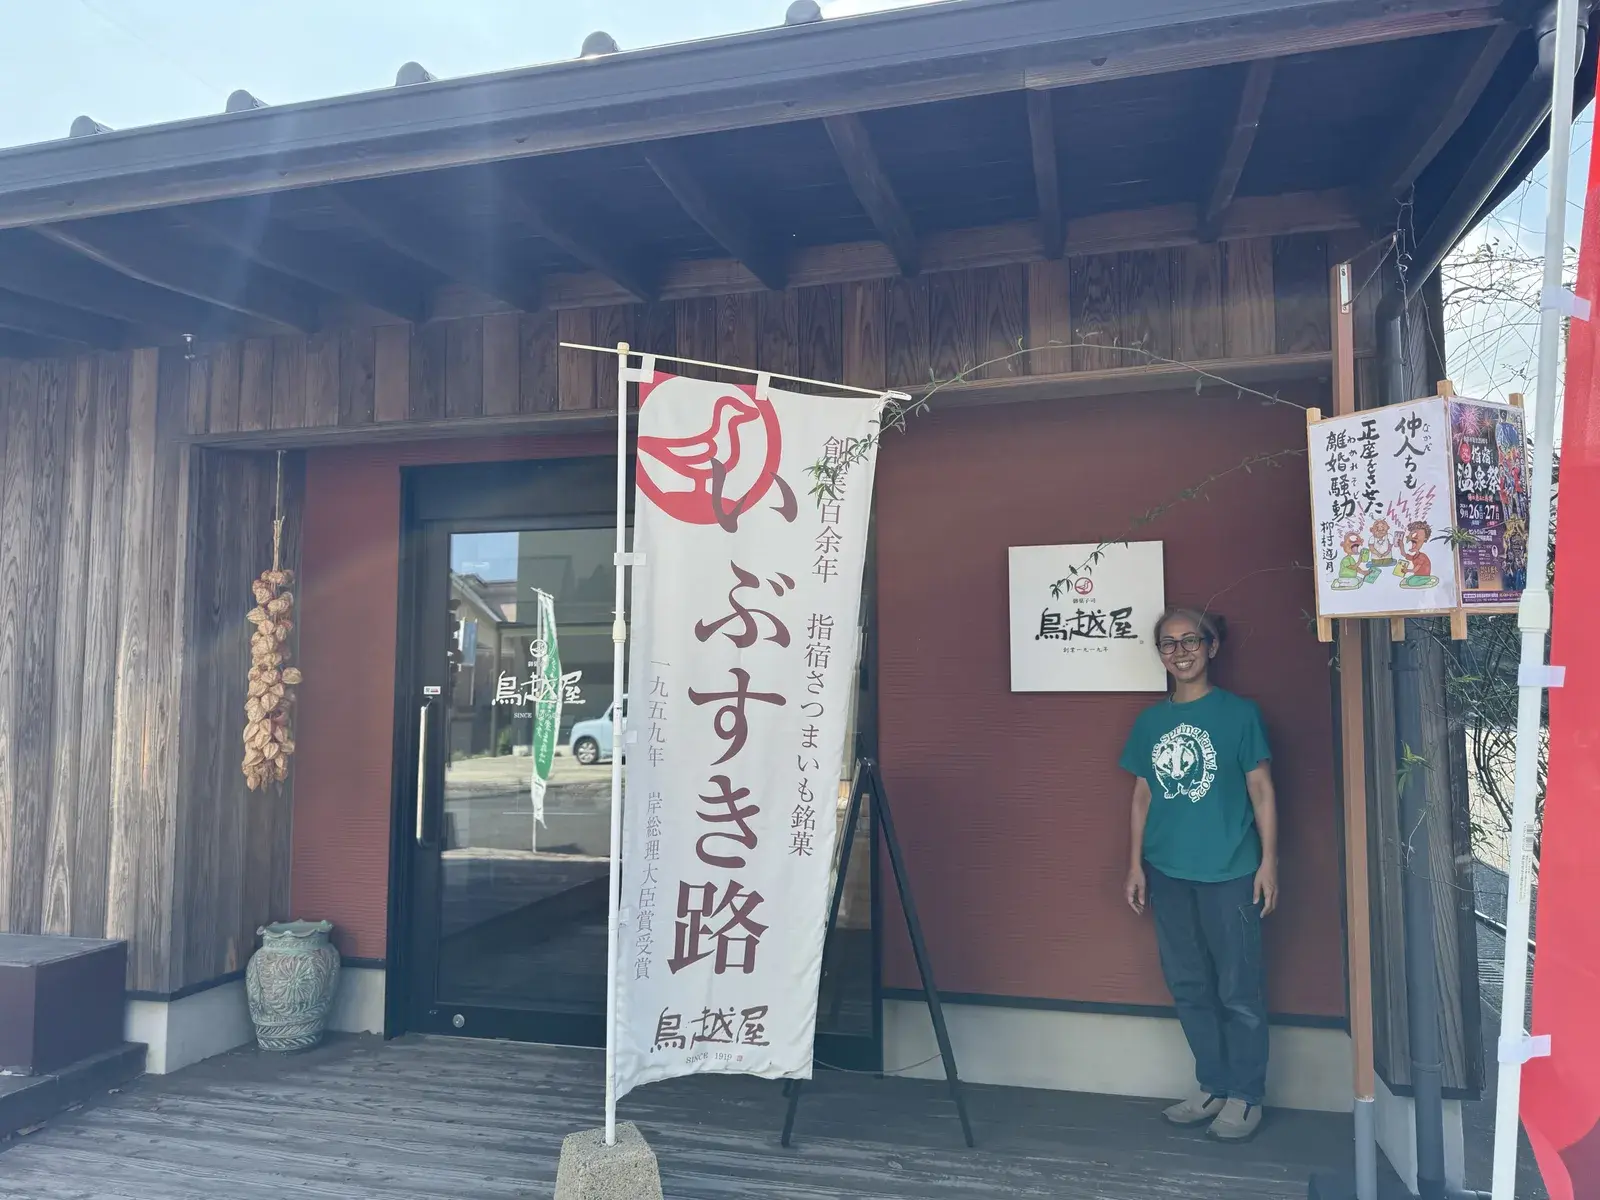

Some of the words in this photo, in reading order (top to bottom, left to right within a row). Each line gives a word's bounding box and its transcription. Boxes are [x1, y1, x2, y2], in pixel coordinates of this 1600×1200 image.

[1325, 429, 1356, 523] 離婚騒動
[1357, 419, 1384, 514] 正座をさせた
[1393, 411, 1426, 490] 仲人ちも
[1457, 462, 1501, 494] 温泉祭
[812, 435, 849, 584] 創業百余年
[1035, 606, 1139, 641] 鳥越屋
[491, 669, 587, 706] 鳥越屋
[513, 711, 533, 719] SINCE
[647, 660, 671, 768] 一九五九年
[667, 457, 799, 976] いぶすき路
[788, 613, 835, 857] 指宿さつまいも銘菓
[1160, 722, 1202, 743] Spring
[1200, 730, 1218, 771] Party!
[634, 791, 663, 981] 岸総理大臣賞受賞
[650, 1004, 771, 1054] 鳥越屋
[685, 1051, 709, 1064] SINCE
[714, 1051, 733, 1062] 1919
